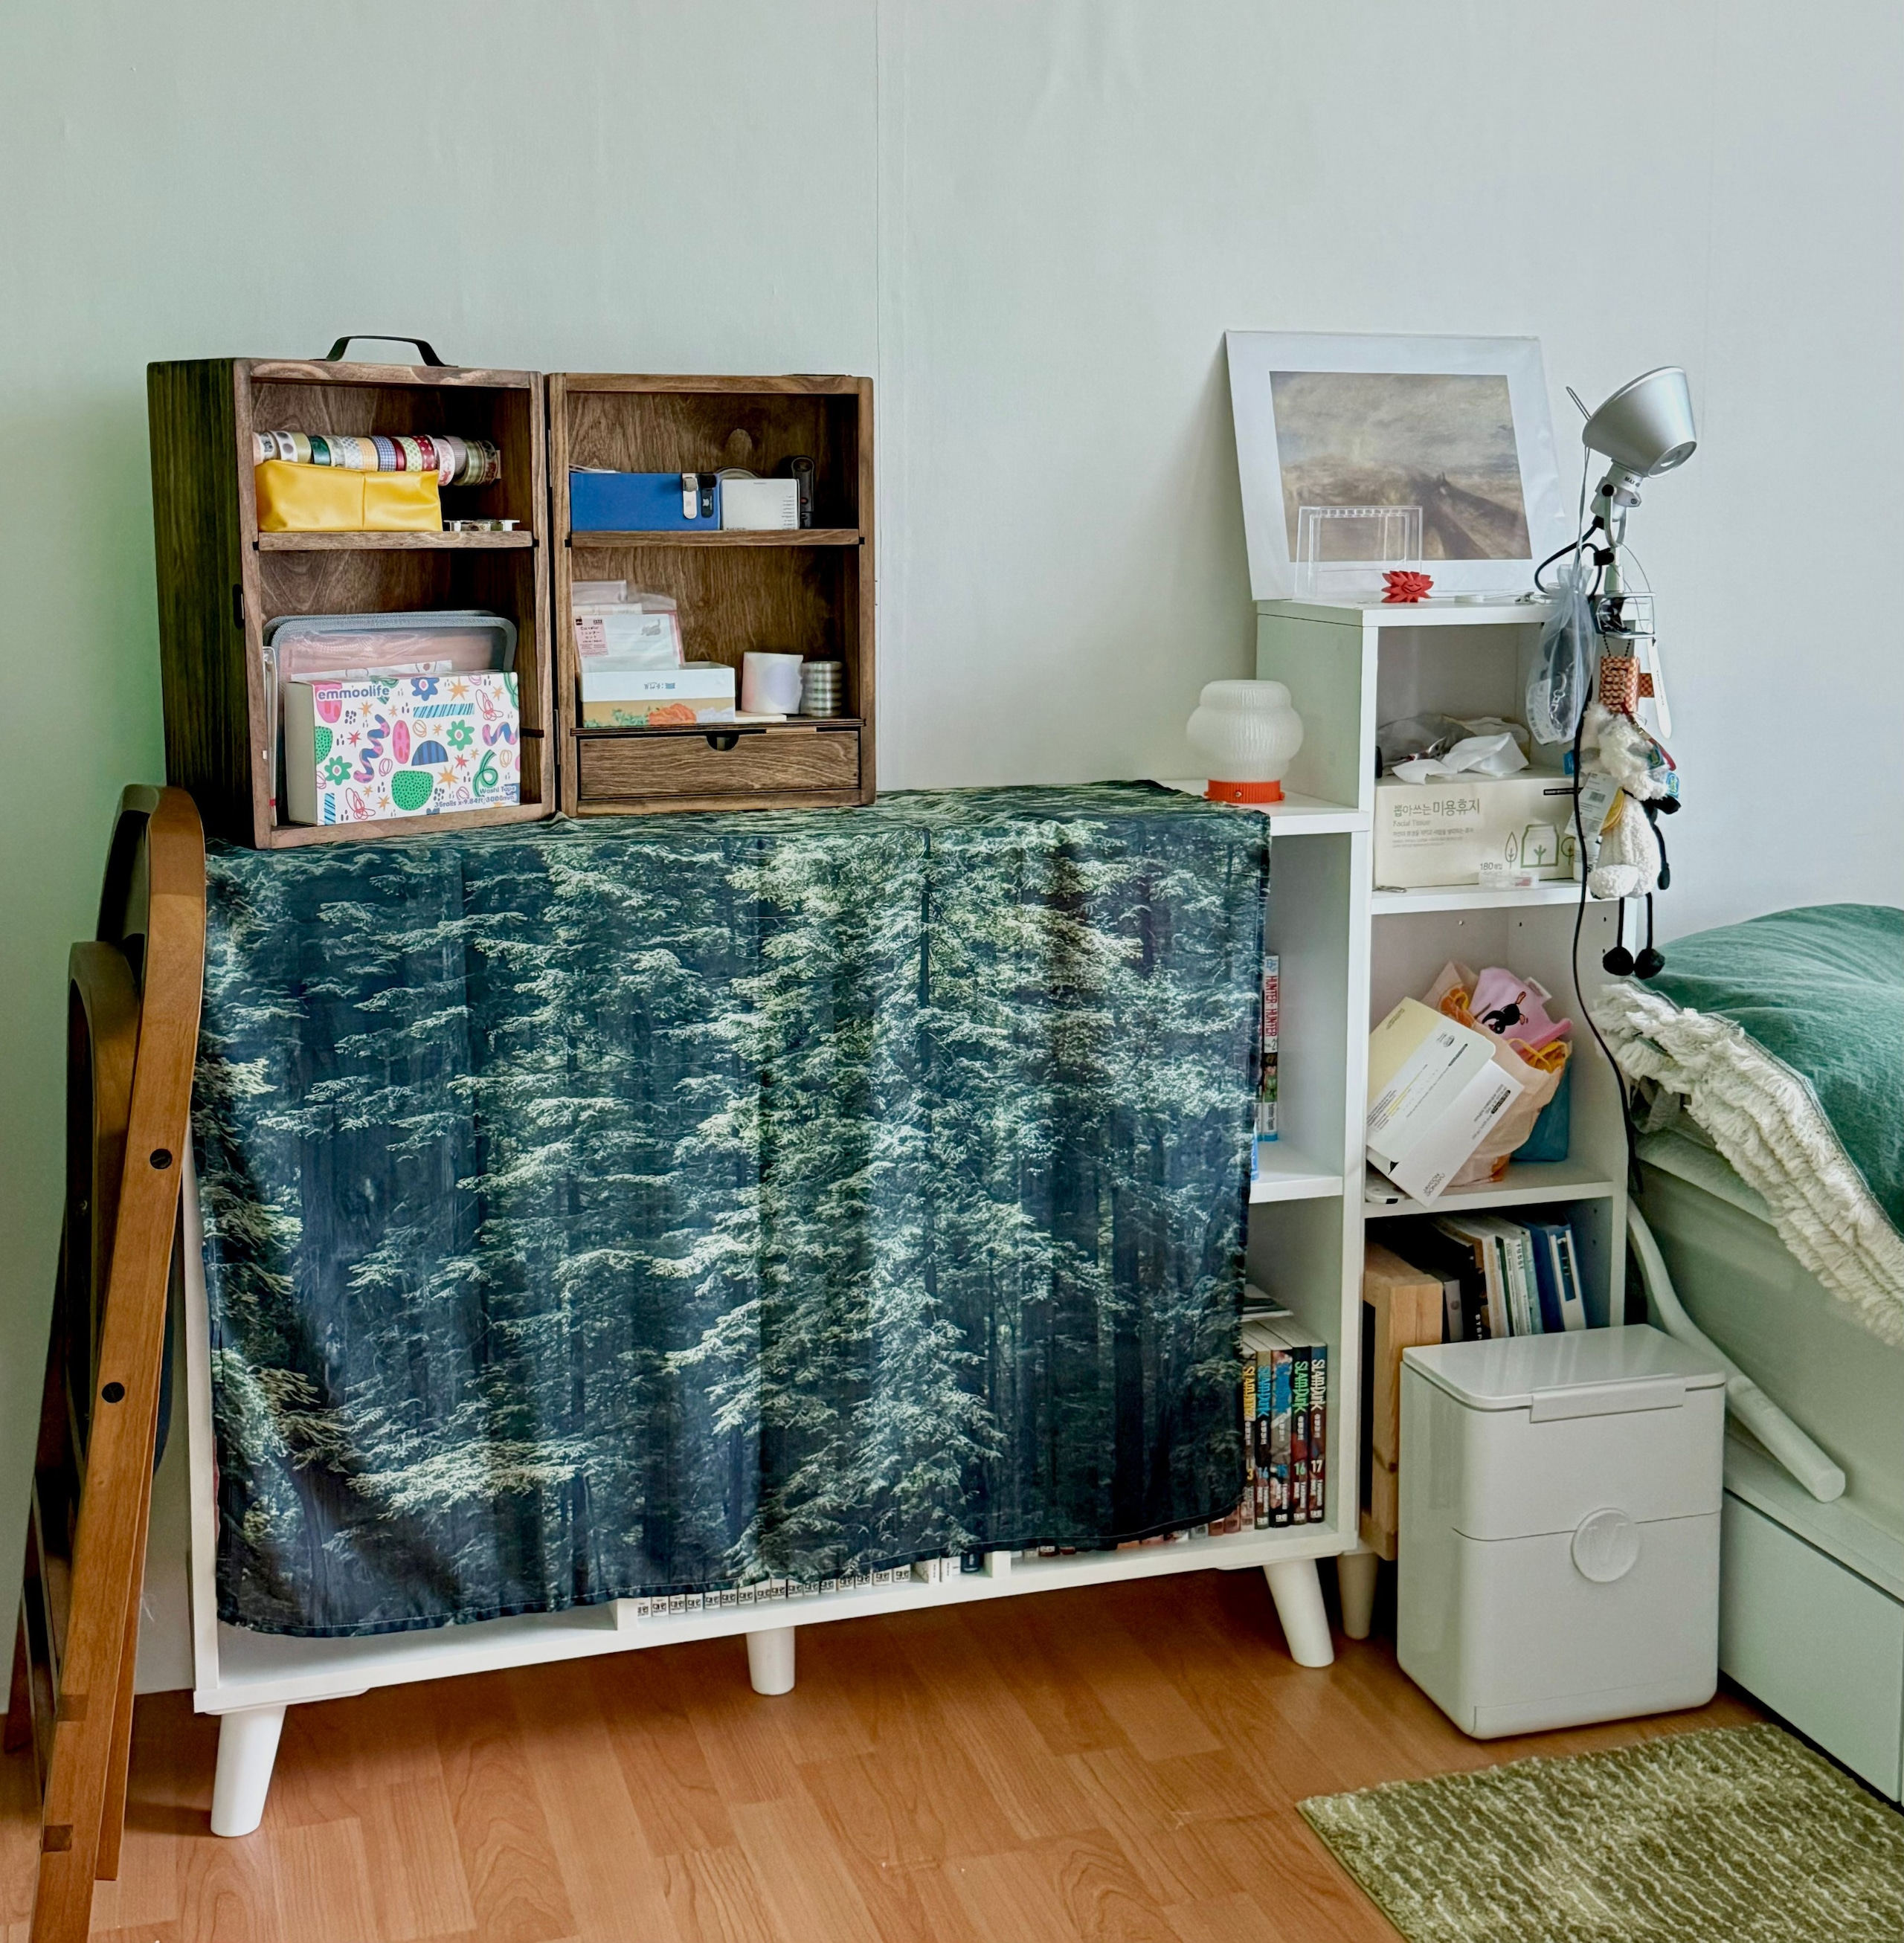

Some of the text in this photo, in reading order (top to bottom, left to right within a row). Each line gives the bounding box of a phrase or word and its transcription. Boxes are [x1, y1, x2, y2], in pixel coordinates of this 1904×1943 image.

[318, 684, 390, 701] emmoolife
[1265, 976, 1278, 1004] HUNTER
[1265, 1008, 1278, 1037] HUNTER
[1294, 1462, 1306, 1475] 16
[1311, 1460, 1323, 1472] 17
